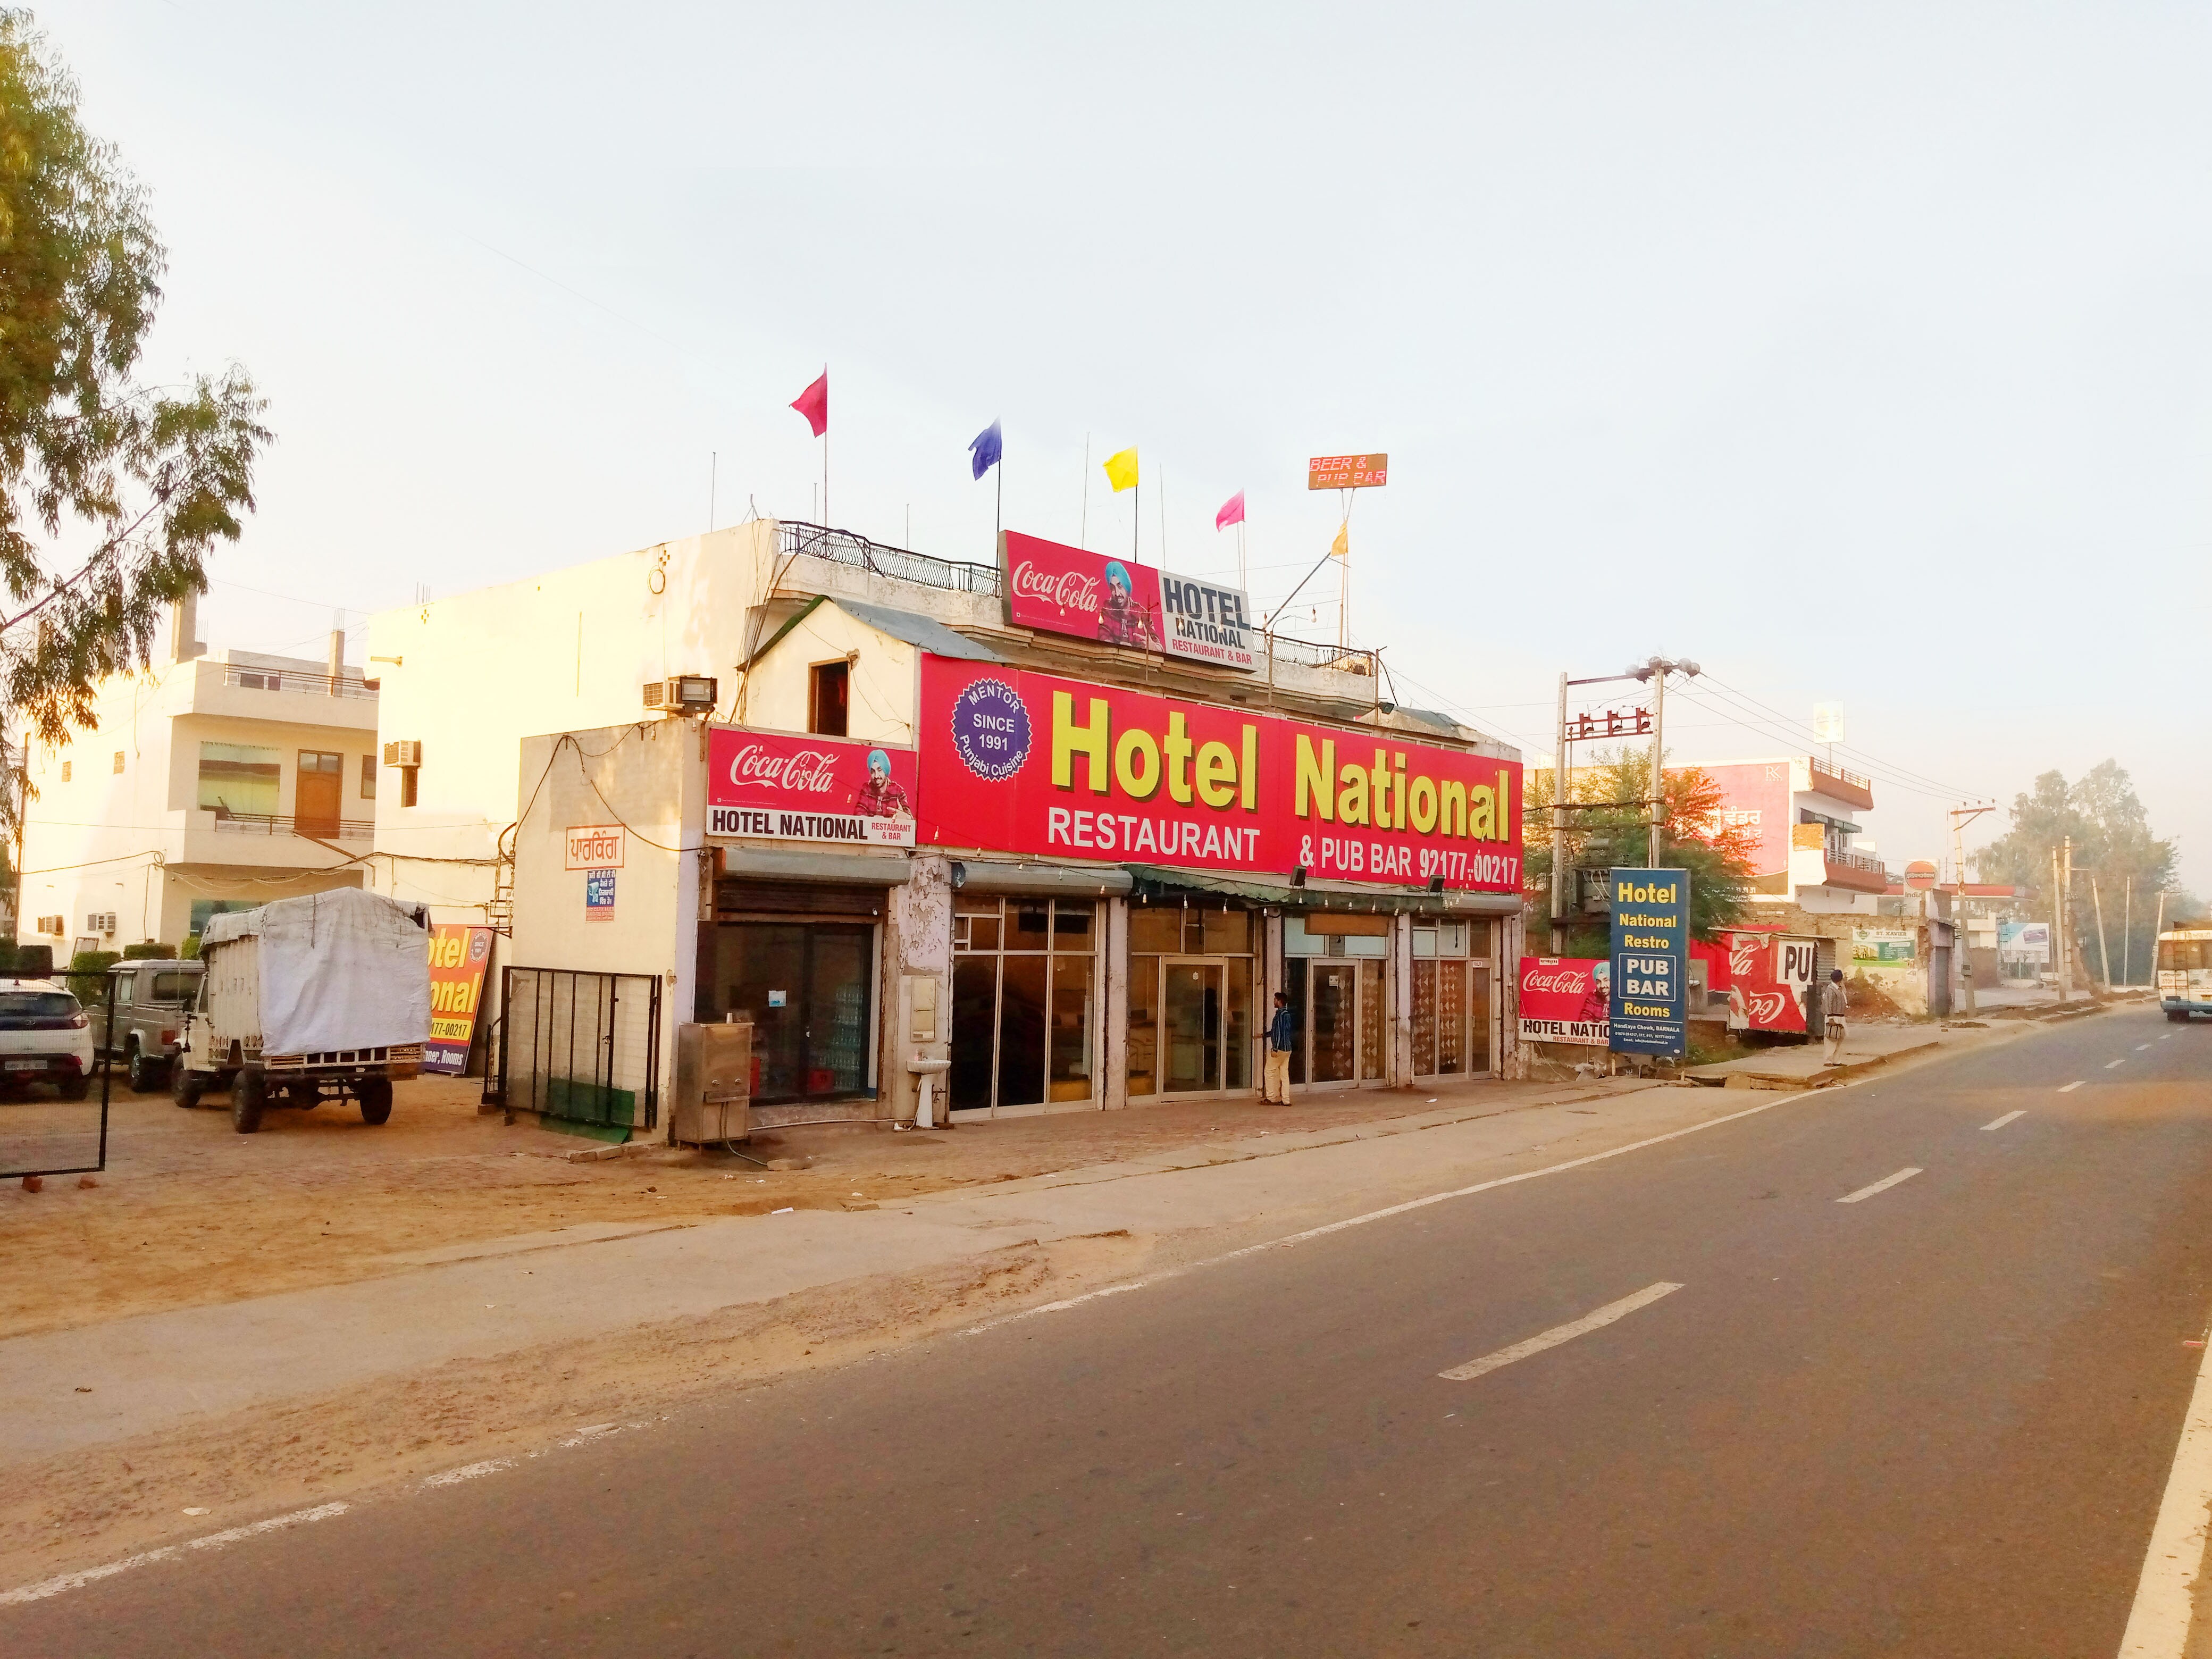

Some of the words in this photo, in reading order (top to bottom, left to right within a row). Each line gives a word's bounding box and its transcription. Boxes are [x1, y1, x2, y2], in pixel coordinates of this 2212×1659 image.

[1310, 457, 1352, 471] BEER
[1356, 457, 1367, 468] &
[1012, 561, 1101, 613] Coca-Cola
[1163, 577, 1251, 631] HOTEL
[1175, 617, 1245, 649] NATIONAL
[1172, 639, 1225, 659] RESTAURANT
[1228, 650, 1234, 661] &
[1235, 652, 1252, 665] BAR
[968, 685, 1019, 714] MENTOR
[973, 713, 1015, 733] SINCE
[979, 734, 1008, 751] 1991
[960, 734, 989, 774] Punjabi
[991, 750, 1023, 776] Cuisine
[730, 744, 841, 793] Coca-Cola
[1051, 690, 1258, 811] Hotel
[1295, 734, 1510, 842] National
[713, 810, 774, 834] HOTEL
[780, 815, 868, 840] NATIONAL
[872, 822, 911, 833] RESTAURANT
[888, 832, 901, 841] BAR
[1048, 807, 1260, 861] RESTAURANT
[1300, 835, 1314, 867] &
[1321, 837, 1364, 872] PUB
[1370, 843, 1412, 877] BAR
[1420, 848, 1518, 885] 92177-00217
[1618, 882, 1677, 903] Hotel
[1619, 914, 1677, 927] National
[1624, 934, 1669, 949] Restro
[1627, 959, 1669, 975] PUB
[1523, 969, 1589, 994] Coca-Cola
[1627, 979, 1669, 996] BAR
[1624, 1002, 1670, 1018] Rooms
[1523, 1020, 1566, 1035] HOTEL
[441, 1050, 463, 1066] Rooms
